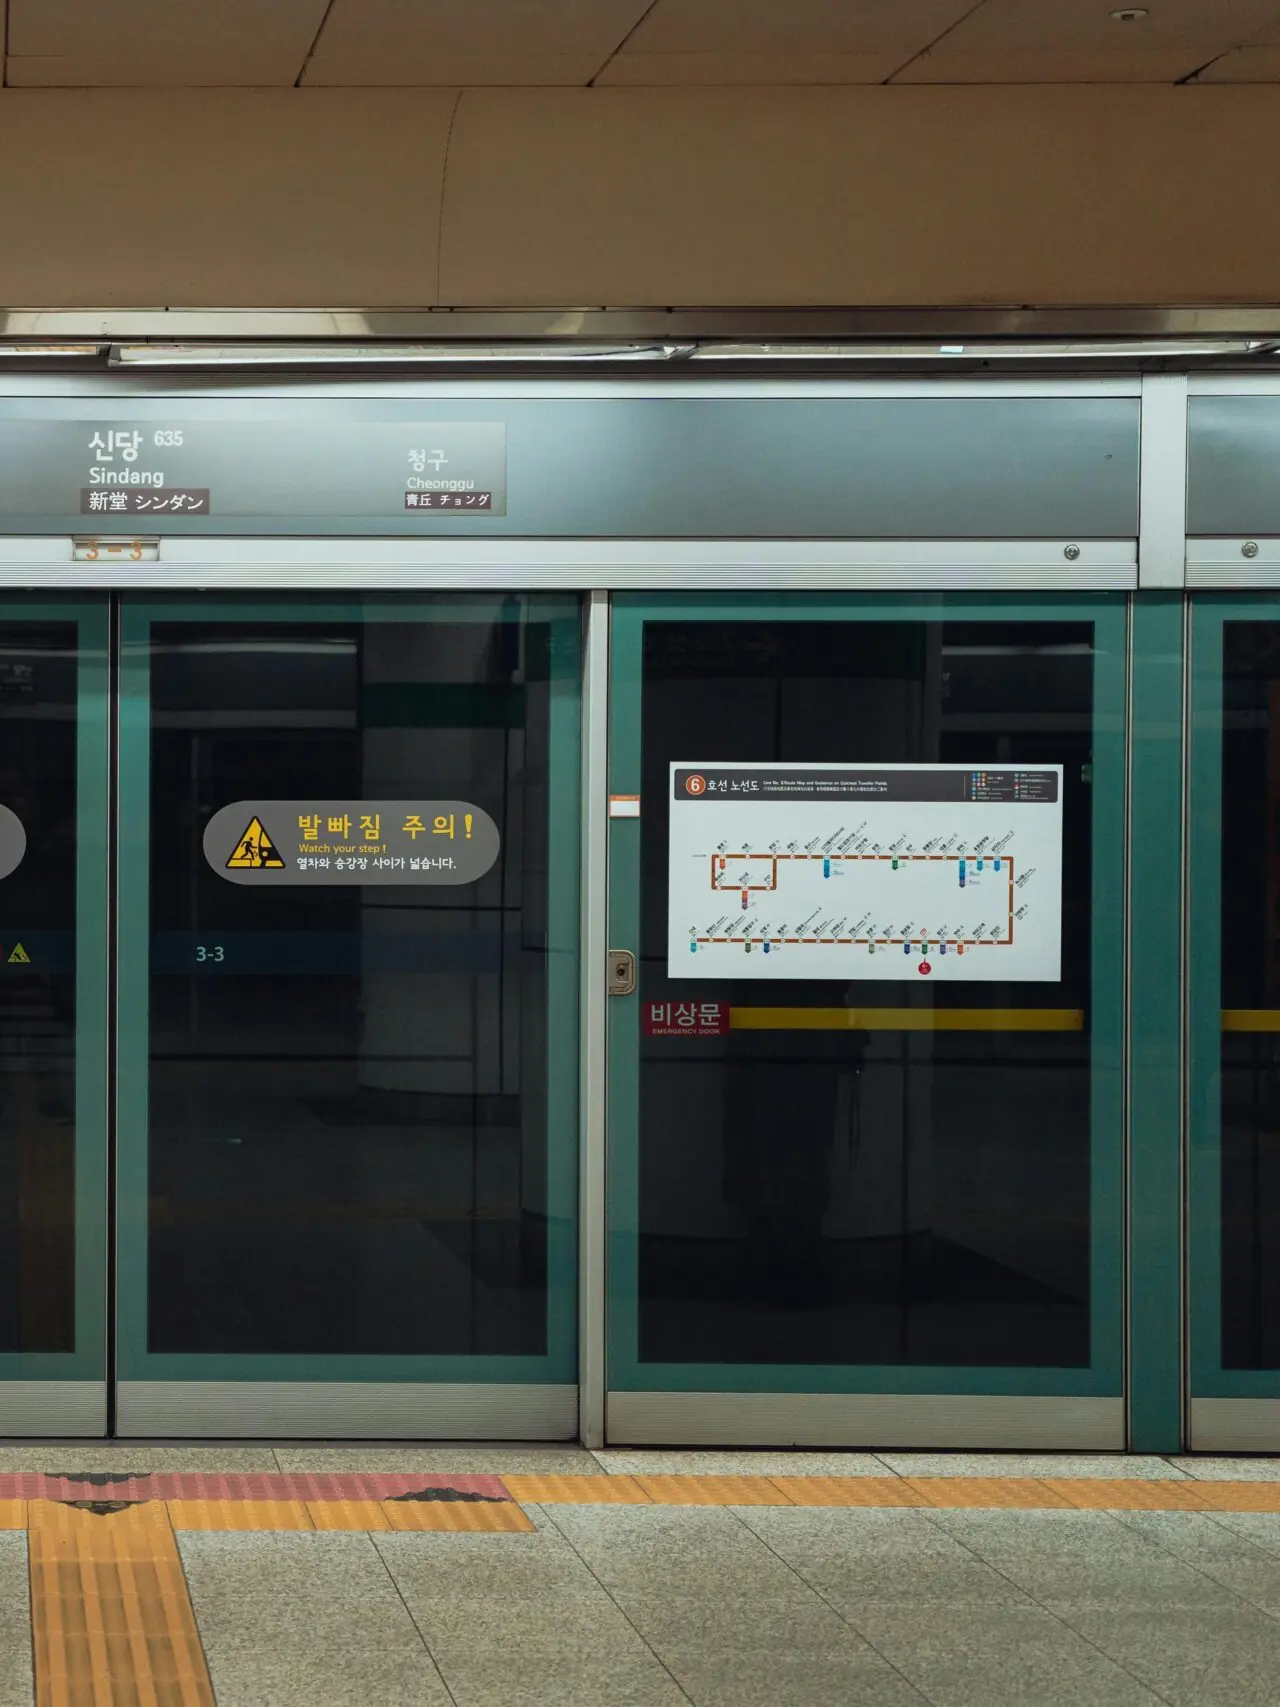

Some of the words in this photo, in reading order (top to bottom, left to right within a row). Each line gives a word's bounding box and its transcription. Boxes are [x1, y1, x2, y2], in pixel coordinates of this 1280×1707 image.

[88, 430, 144, 462] 신당
[154, 430, 184, 446] 635
[407, 448, 449, 472] 청구
[89, 466, 164, 488] Sindang
[406, 476, 475, 492] Cheonggu
[89, 491, 128, 511] 新堂
[135, 494, 204, 511] シンダン
[691, 778, 700, 792] 6
[707, 780, 728, 792] 호선
[730, 780, 760, 792] 노선도
[298, 814, 380, 840] 발빠짐
[402, 814, 473, 840] 주의!
[299, 844, 330, 853] Watch
[333, 845, 356, 855] your
[297, 857, 331, 870] 열차와
[334, 857, 369, 870] 승강장
[372, 857, 406, 870] 사이가
[196, 946, 225, 962] 3-3
[651, 1003, 721, 1027] 비상문
